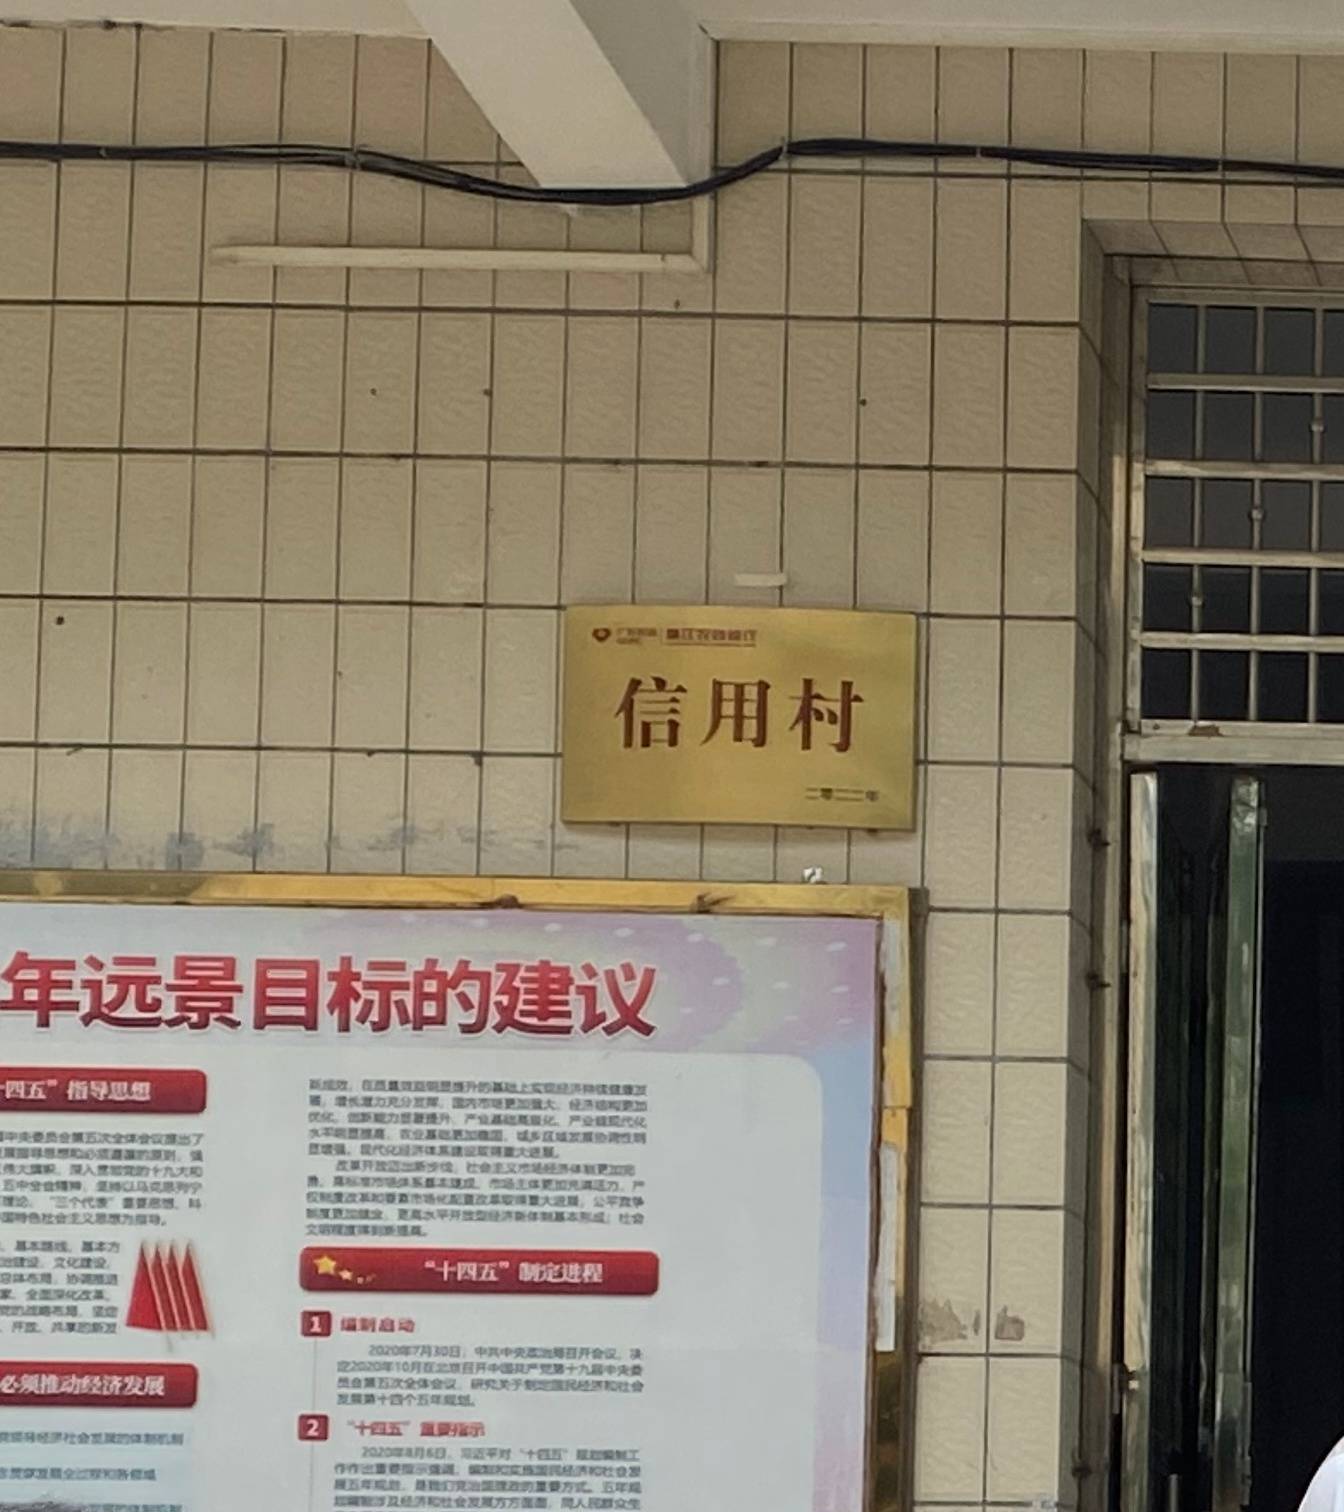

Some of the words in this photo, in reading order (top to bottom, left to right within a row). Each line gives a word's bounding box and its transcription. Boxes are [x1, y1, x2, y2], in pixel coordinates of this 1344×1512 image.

[615, 676, 865, 752] 信用村
[0, 951, 656, 1037] 年远景目标的建议
